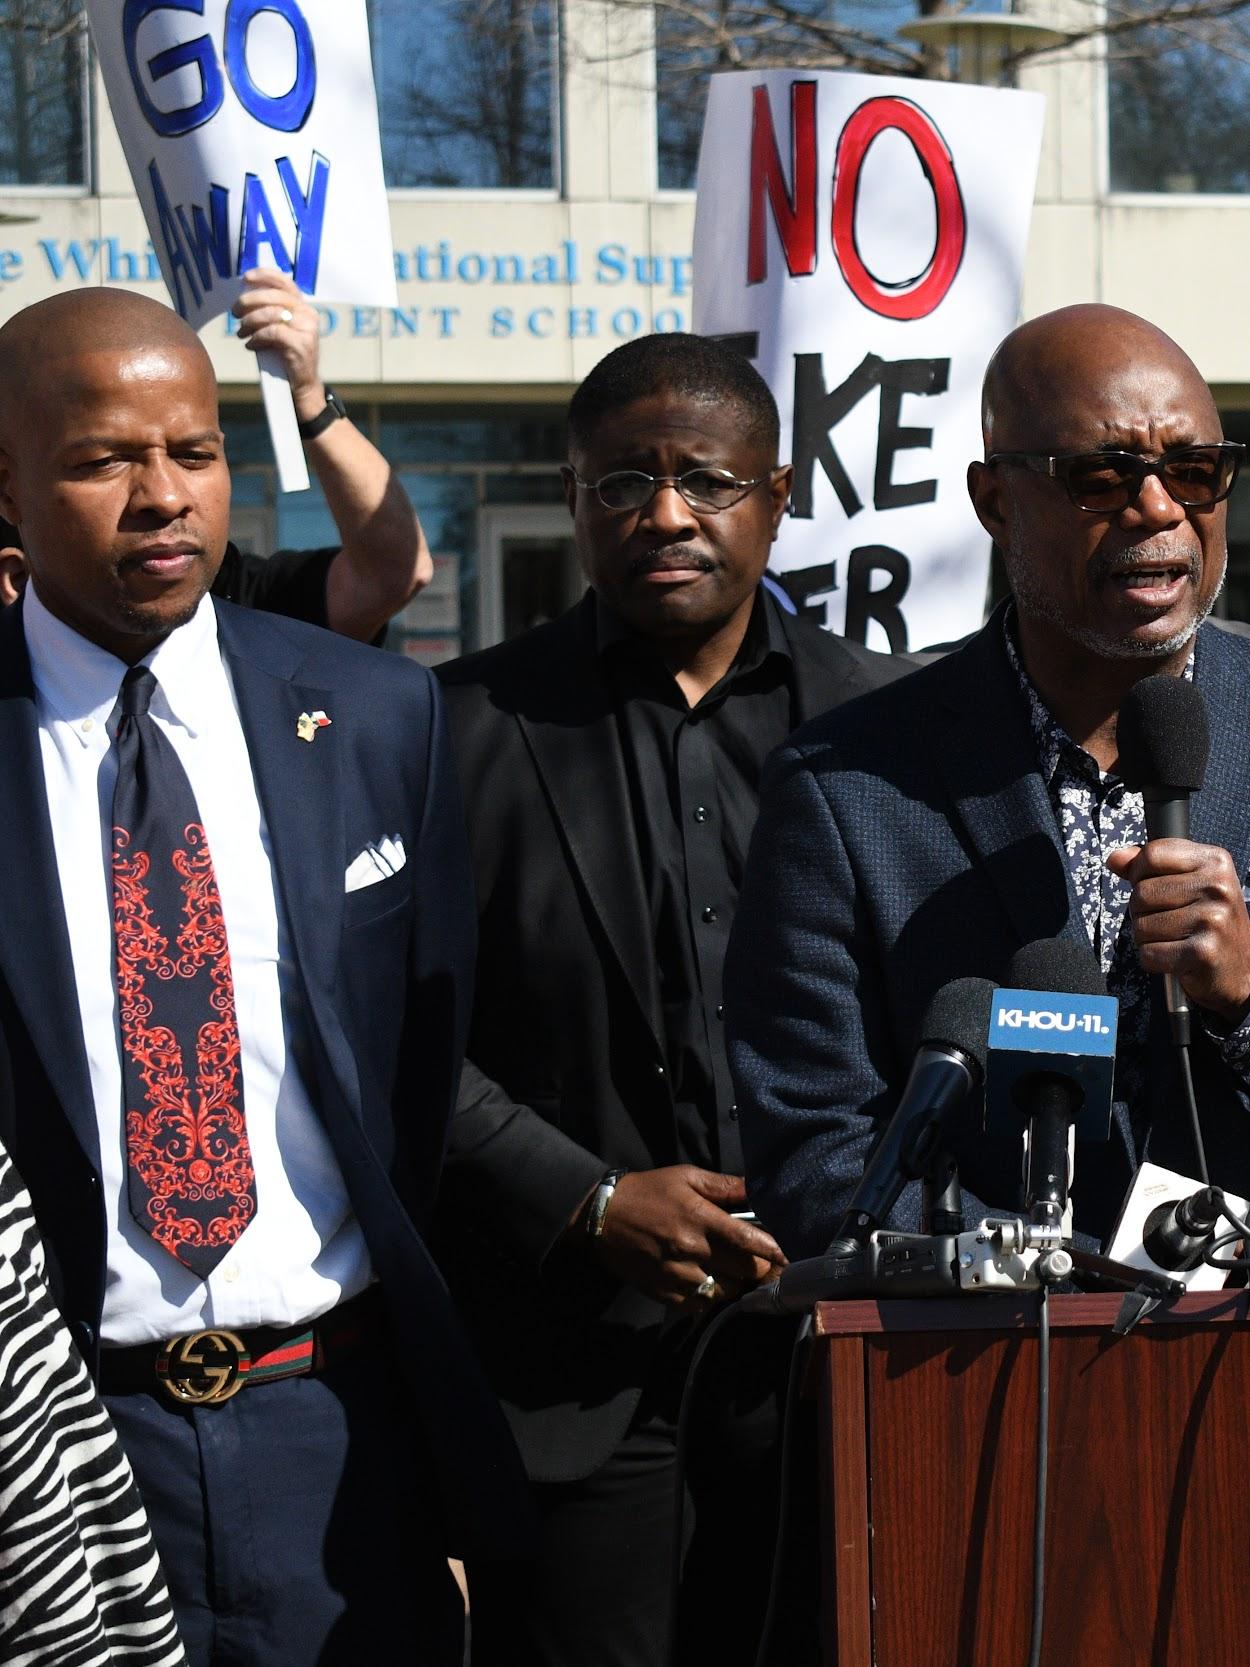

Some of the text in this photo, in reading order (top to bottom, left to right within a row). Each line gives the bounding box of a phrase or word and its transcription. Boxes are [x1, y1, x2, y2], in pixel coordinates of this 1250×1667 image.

[122, 0, 318, 137] GO
[149, 150, 331, 320] AWAY
[745, 80, 967, 321] NO
[38, 236, 161, 282] Whi
[393, 240, 578, 285] ational
[595, 242, 693, 297] Sup
[490, 304, 686, 338] SCHOO
[768, 544, 911, 656] ER
